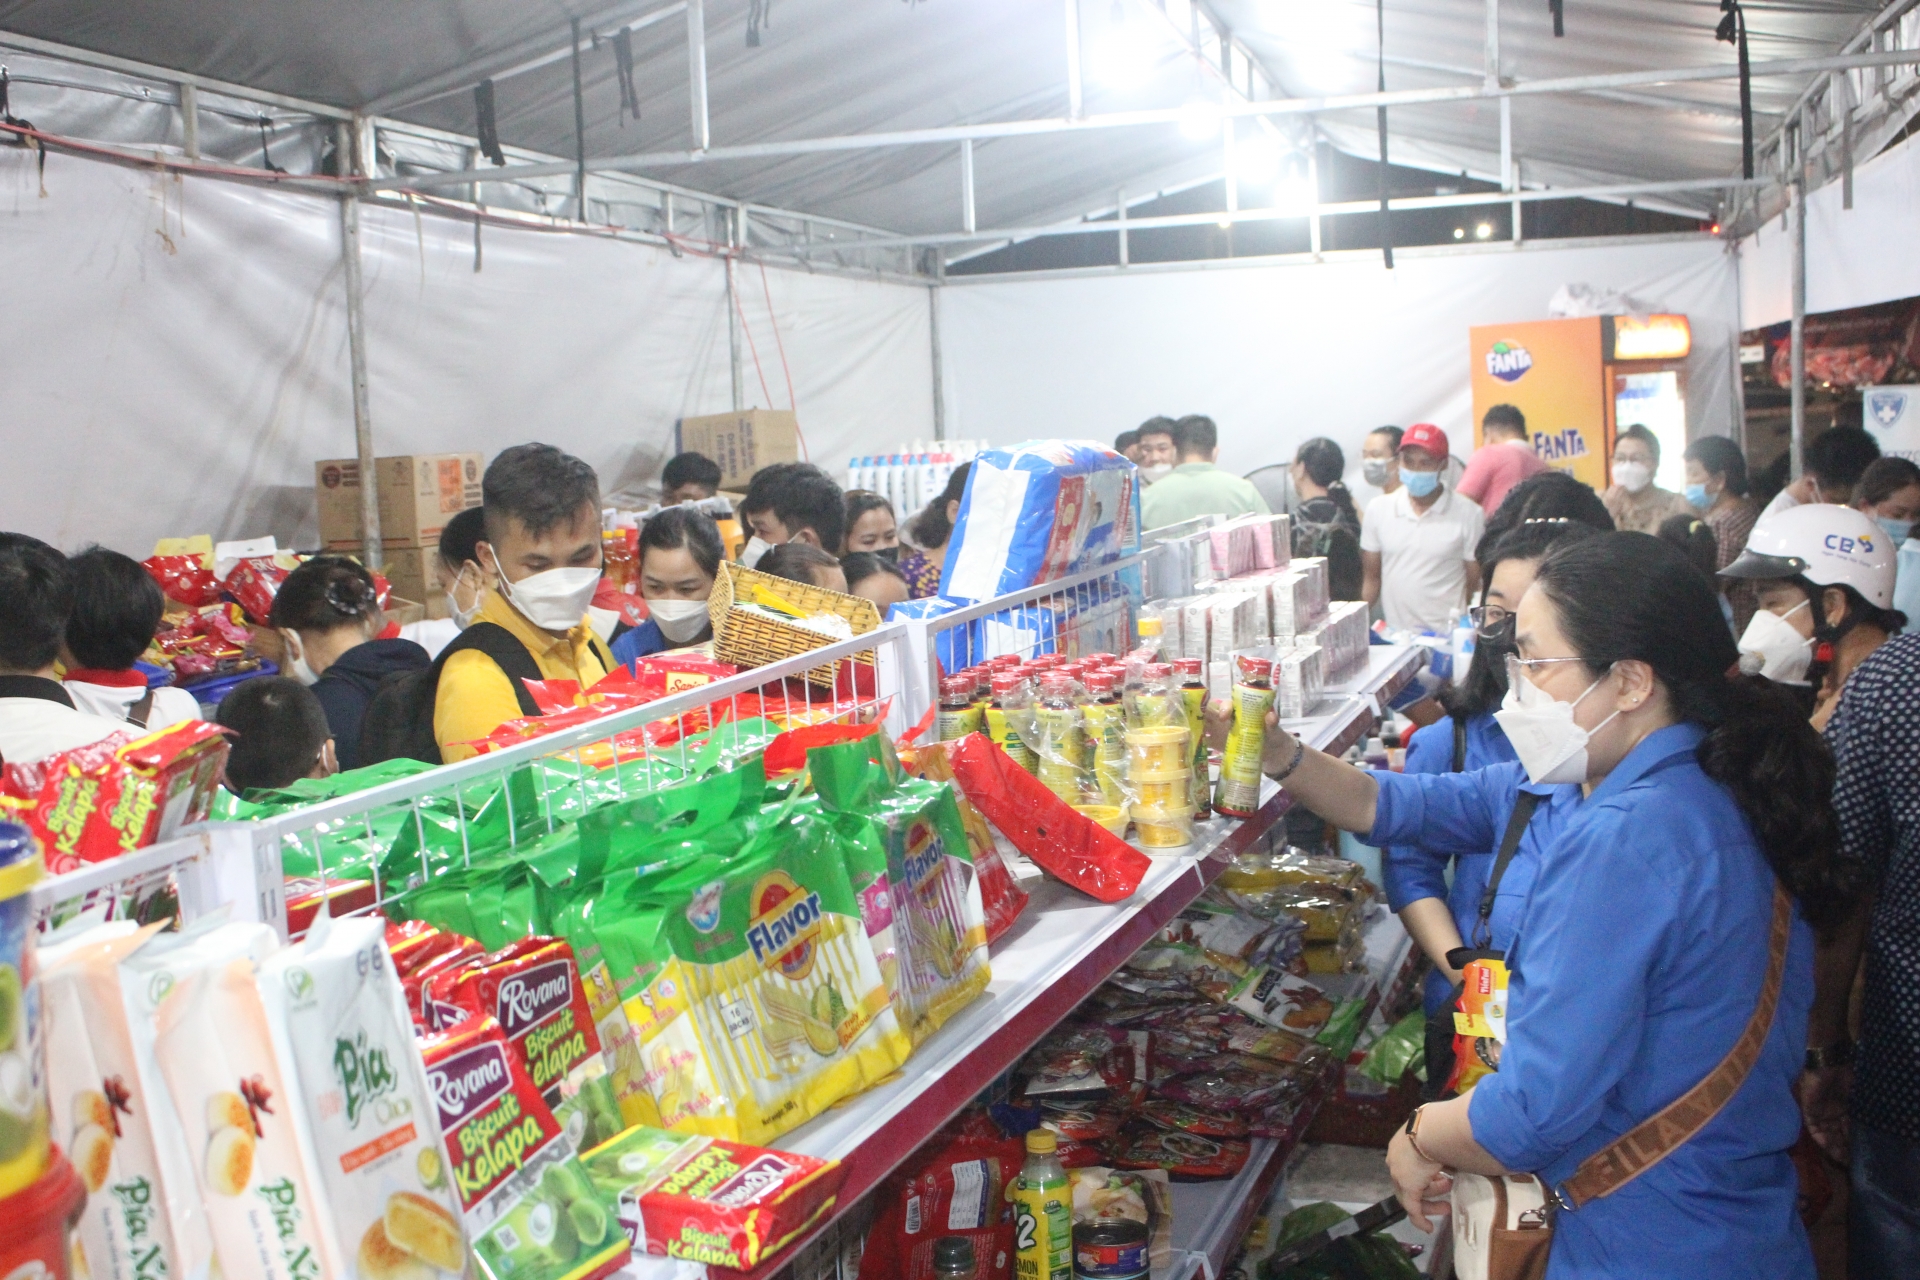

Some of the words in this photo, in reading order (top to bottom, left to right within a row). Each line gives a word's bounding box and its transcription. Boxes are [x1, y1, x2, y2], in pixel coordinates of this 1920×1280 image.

[1486, 348, 1532, 375] FANTA
[1534, 428, 1587, 459] FANTA
[747, 892, 821, 962] Flavor
[501, 975, 566, 1027] Rovana
[730, 1008, 741, 1018] 16
[525, 1008, 574, 1060] Biscuit
[530, 1031, 587, 1087] elapa
[427, 1059, 502, 1115] Rovana
[458, 1093, 520, 1156] Biscuit
[454, 1116, 544, 1202] Kelapa
[658, 1146, 733, 1195] Kelapa
[688, 1160, 741, 1197] Biscuit
[681, 1226, 730, 1249] Biscuit
